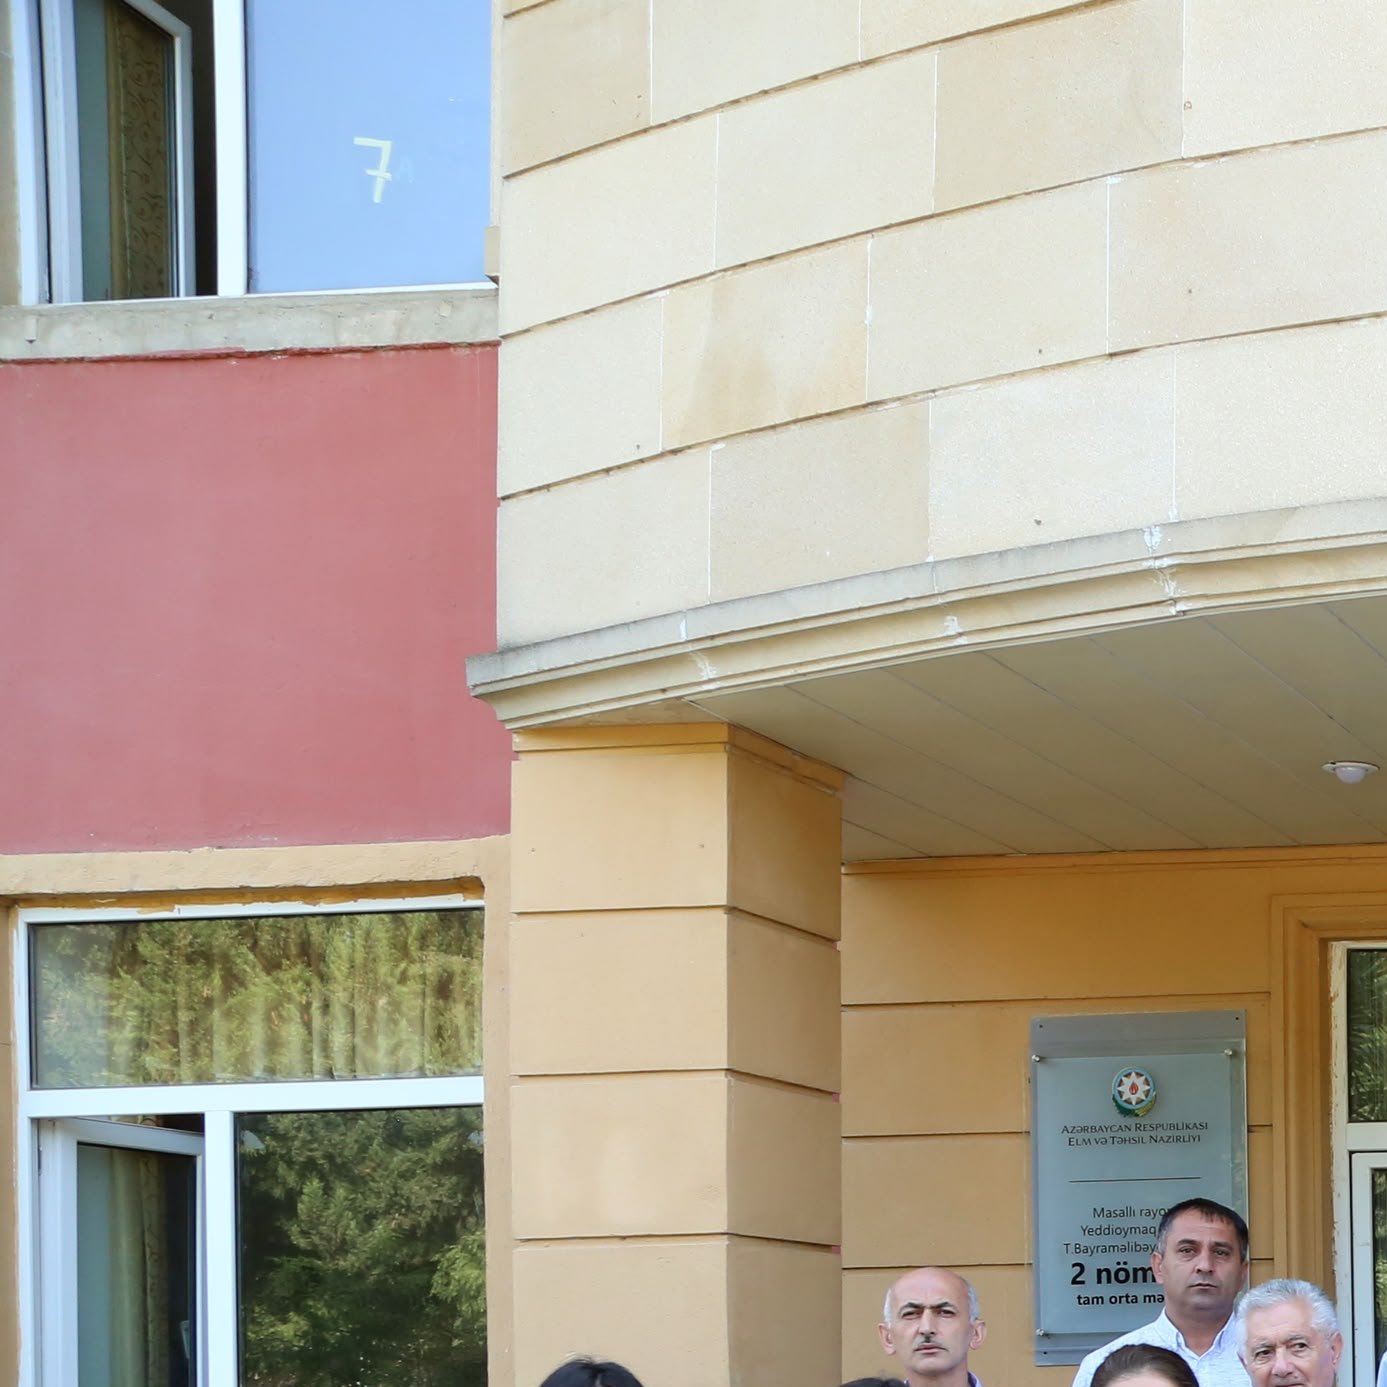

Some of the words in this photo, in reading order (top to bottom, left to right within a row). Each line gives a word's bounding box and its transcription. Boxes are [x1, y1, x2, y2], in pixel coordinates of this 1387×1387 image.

[353, 136, 392, 203] 7
[1068, 1136, 1092, 1146] ELM
[1139, 1207, 1169, 1220] rayo
[1080, 1224, 1157, 1239] Yeddioymaq
[1063, 1241, 1159, 1257] T.Bayraməlibəy
[1071, 1262, 1086, 1286] 2
[1096, 1260, 1156, 1285] nöm
[1077, 1294, 1105, 1306] tam
[1109, 1293, 1139, 1305] orta
[1143, 1294, 1165, 1304] mə
